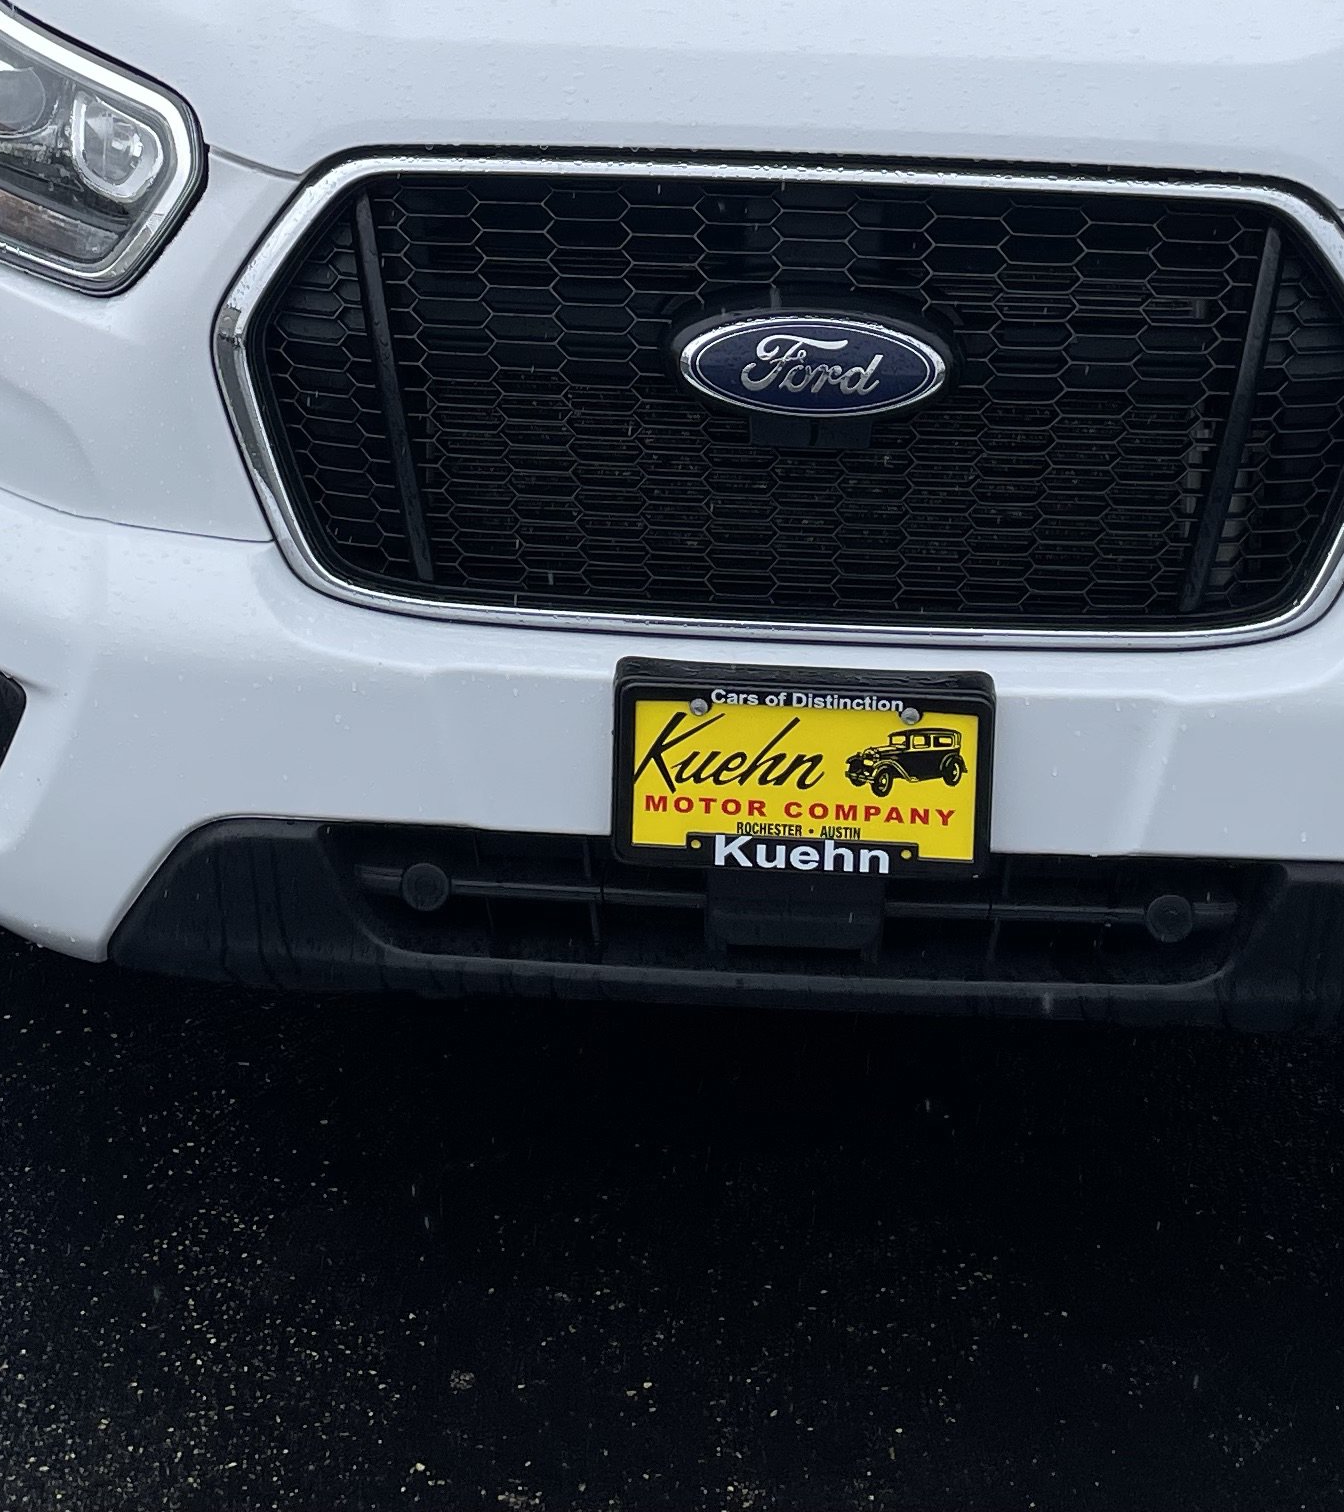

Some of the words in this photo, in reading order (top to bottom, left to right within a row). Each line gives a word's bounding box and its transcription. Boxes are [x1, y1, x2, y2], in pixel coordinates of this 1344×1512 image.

[740, 334, 884, 396] Ford
[710, 688, 759, 707] Cars
[764, 691, 788, 708] of
[791, 692, 904, 712] Distinction
[633, 711, 825, 794] Kuehn
[644, 794, 767, 818] MOTOR
[783, 801, 956, 826] COMPANY
[736, 821, 803, 839] ROCHESTER
[820, 824, 861, 840] AUSTIN
[713, 834, 890, 875] Kuehn
